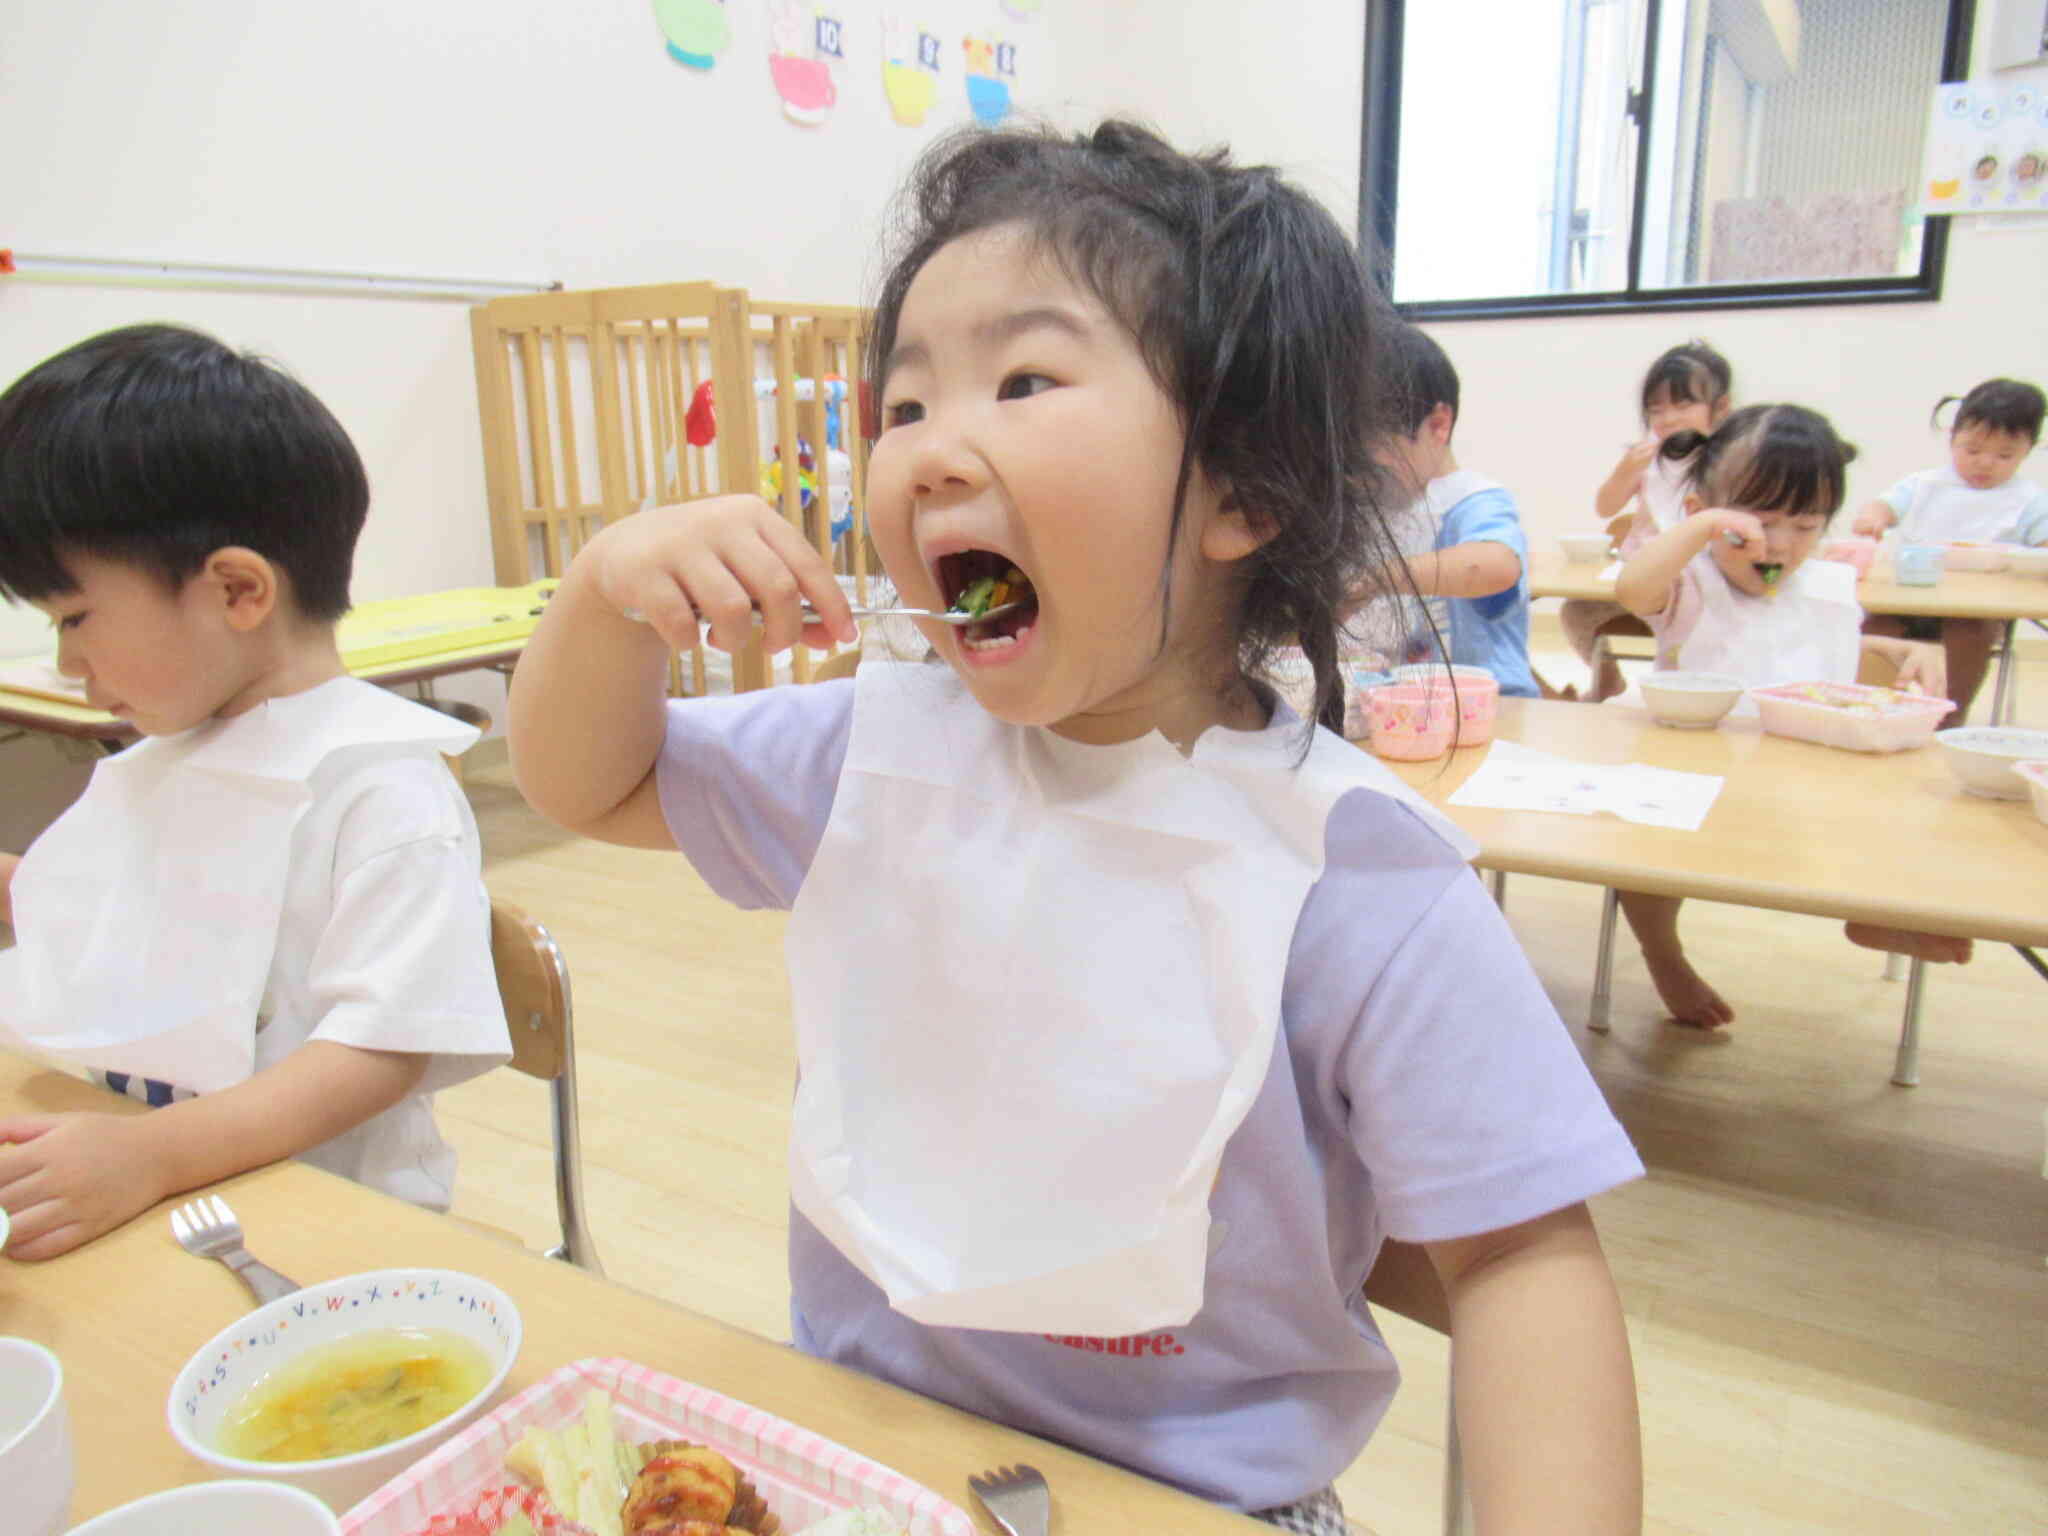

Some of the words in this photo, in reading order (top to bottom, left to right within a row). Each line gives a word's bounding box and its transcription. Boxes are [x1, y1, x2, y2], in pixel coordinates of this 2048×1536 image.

[292, 1300, 304, 1317] V
[326, 1295, 344, 1312] W
[366, 1285, 383, 1303] X
